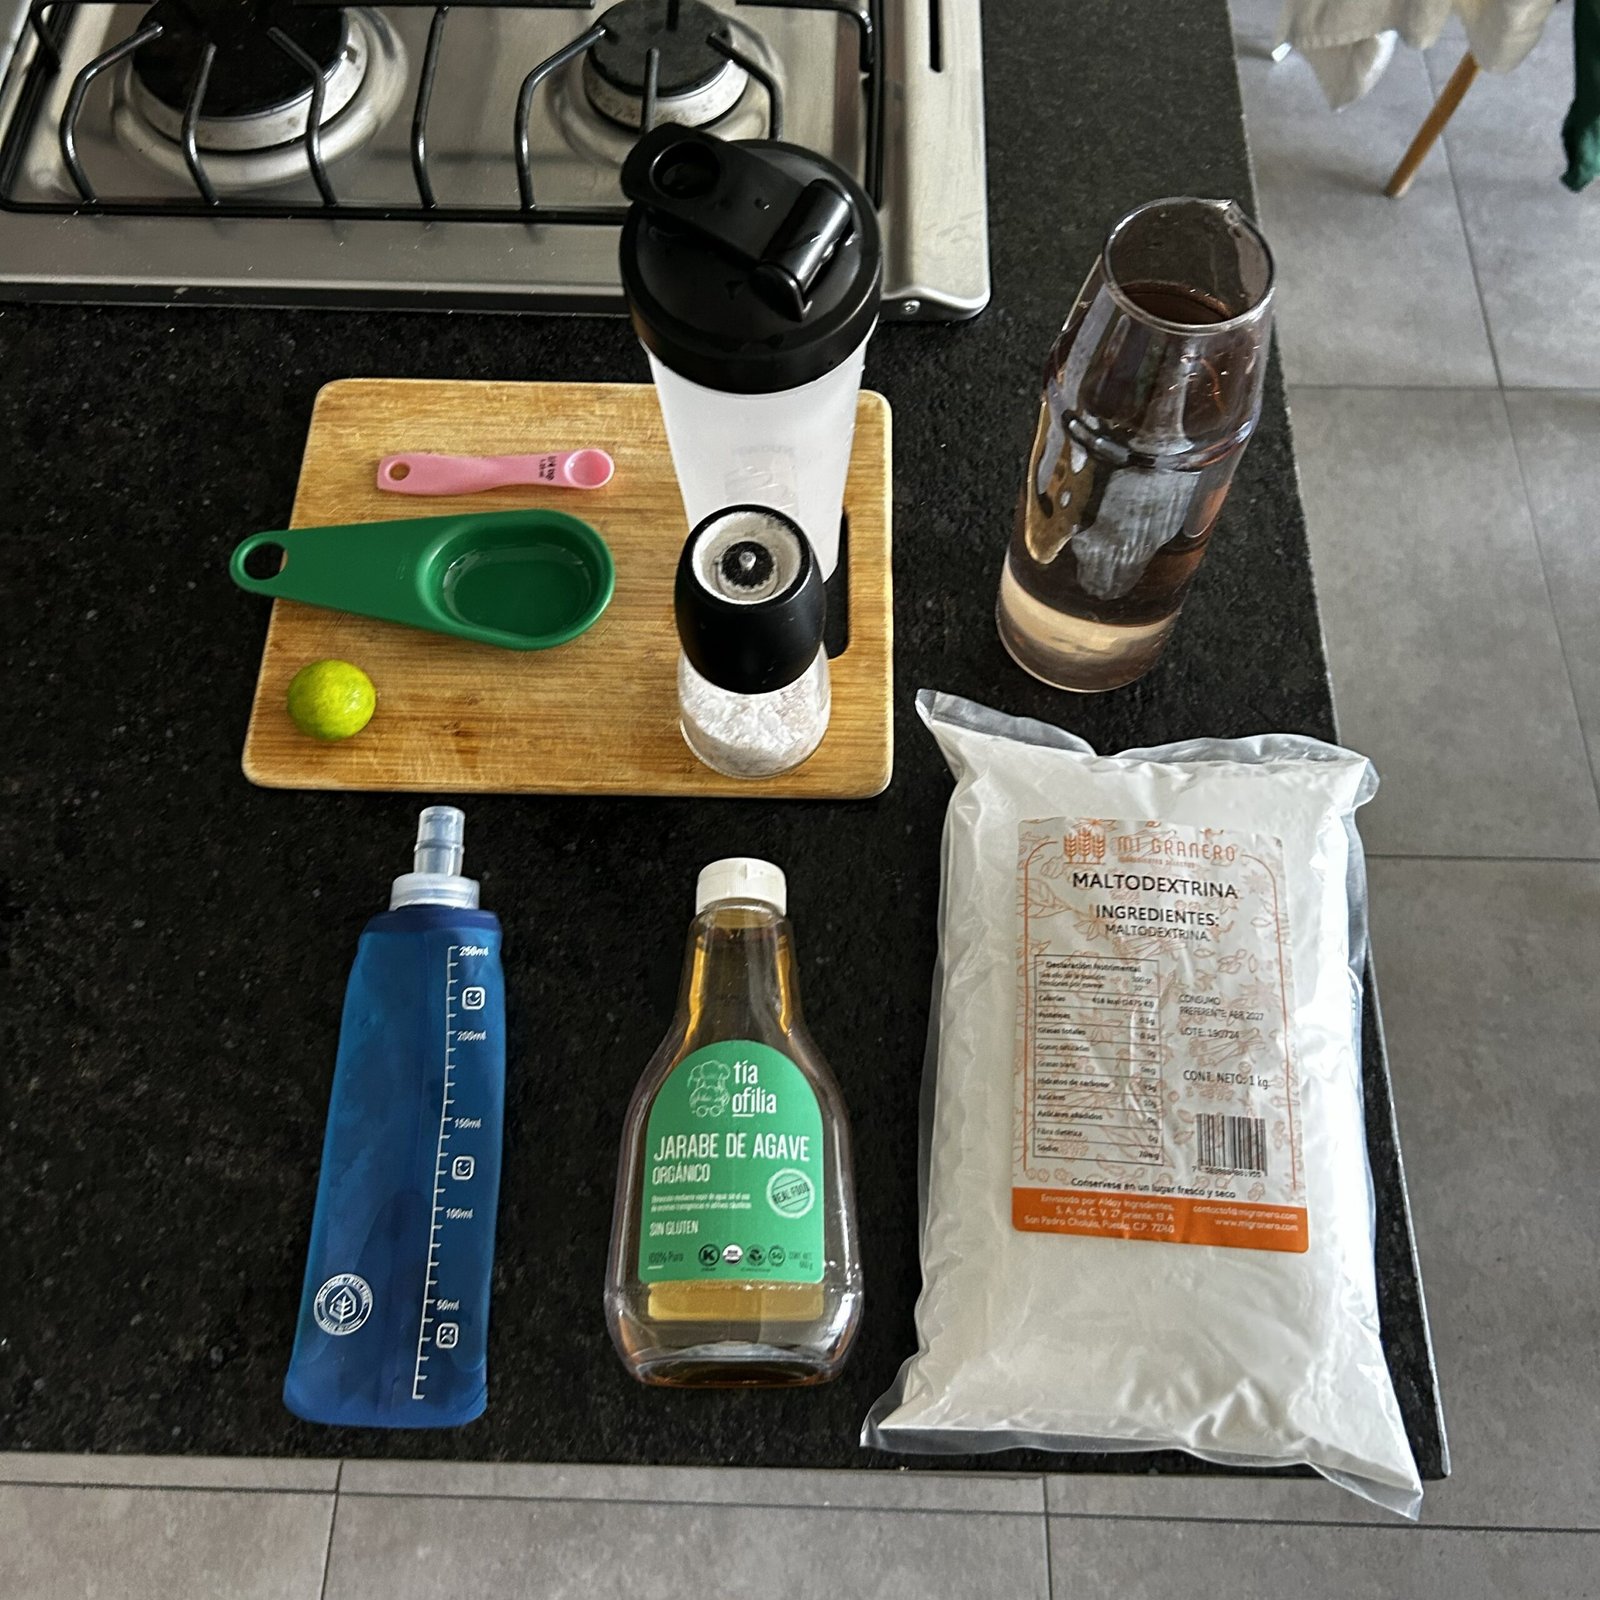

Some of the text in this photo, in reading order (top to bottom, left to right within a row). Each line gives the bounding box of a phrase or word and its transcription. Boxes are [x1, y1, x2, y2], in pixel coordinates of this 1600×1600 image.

[1116, 836, 1141, 851] MI
[1073, 872, 1239, 899] MALTODEXTRINA
[1096, 905, 1219, 927] INGREDIENTES:
[733, 1060, 758, 1085] tía
[732, 1087, 777, 1115] ofilia
[653, 1132, 810, 1162] JARABE DE AGAVE
[652, 1162, 710, 1185] ORGÁNICO
[665, 1220, 698, 1236] GLUTEN
